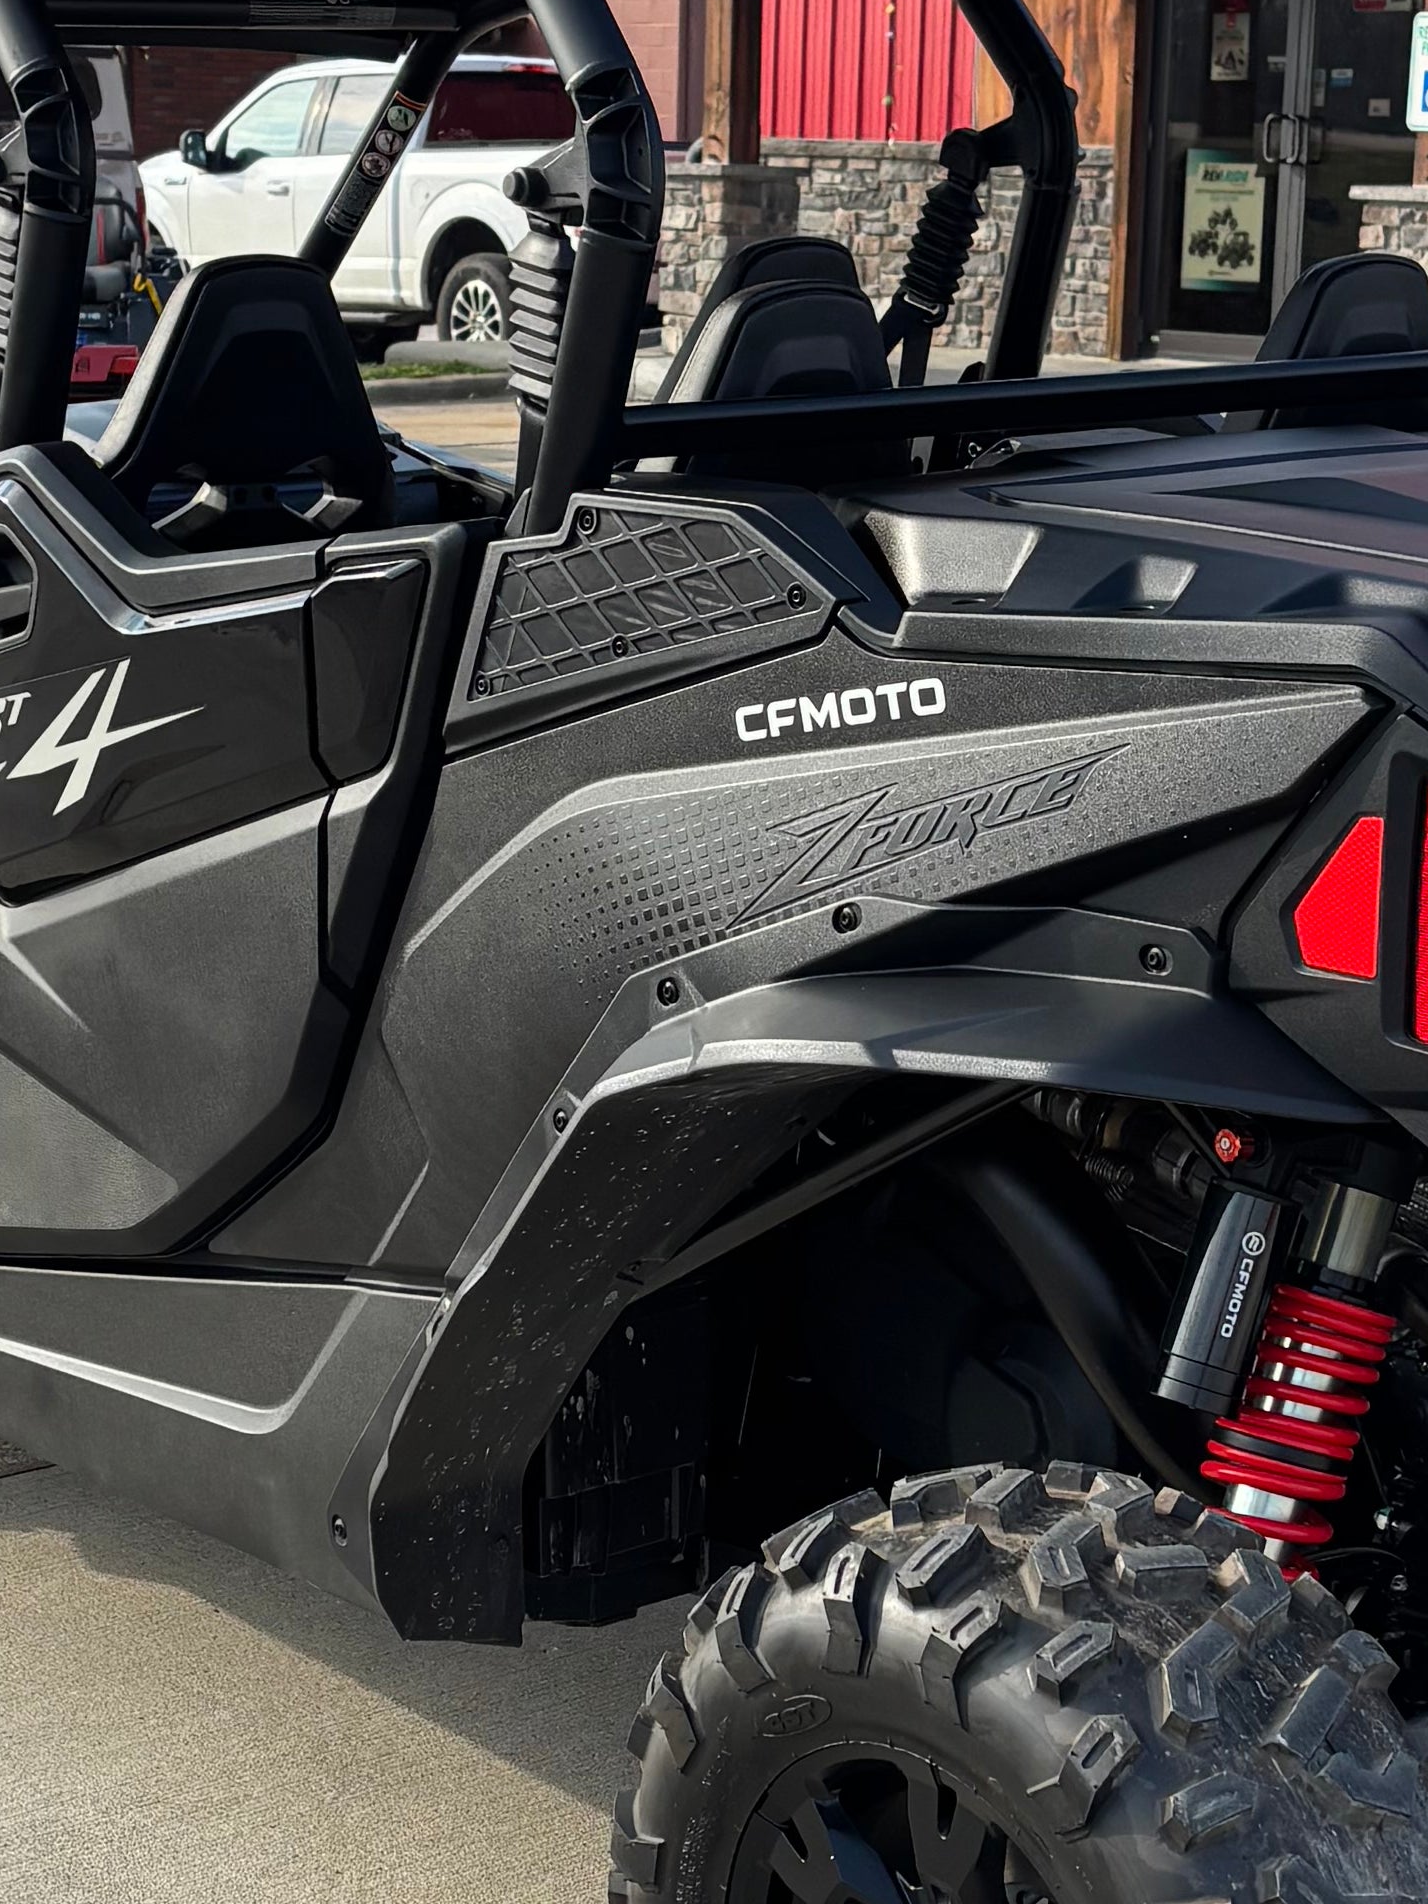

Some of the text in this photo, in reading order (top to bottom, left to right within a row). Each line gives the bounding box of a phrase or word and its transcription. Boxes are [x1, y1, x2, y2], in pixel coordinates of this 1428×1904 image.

[735, 677, 946, 742] CFMOTO
[727, 742, 1132, 931] ZFORCE
[1220, 1258, 1254, 1338] CFMOTO
